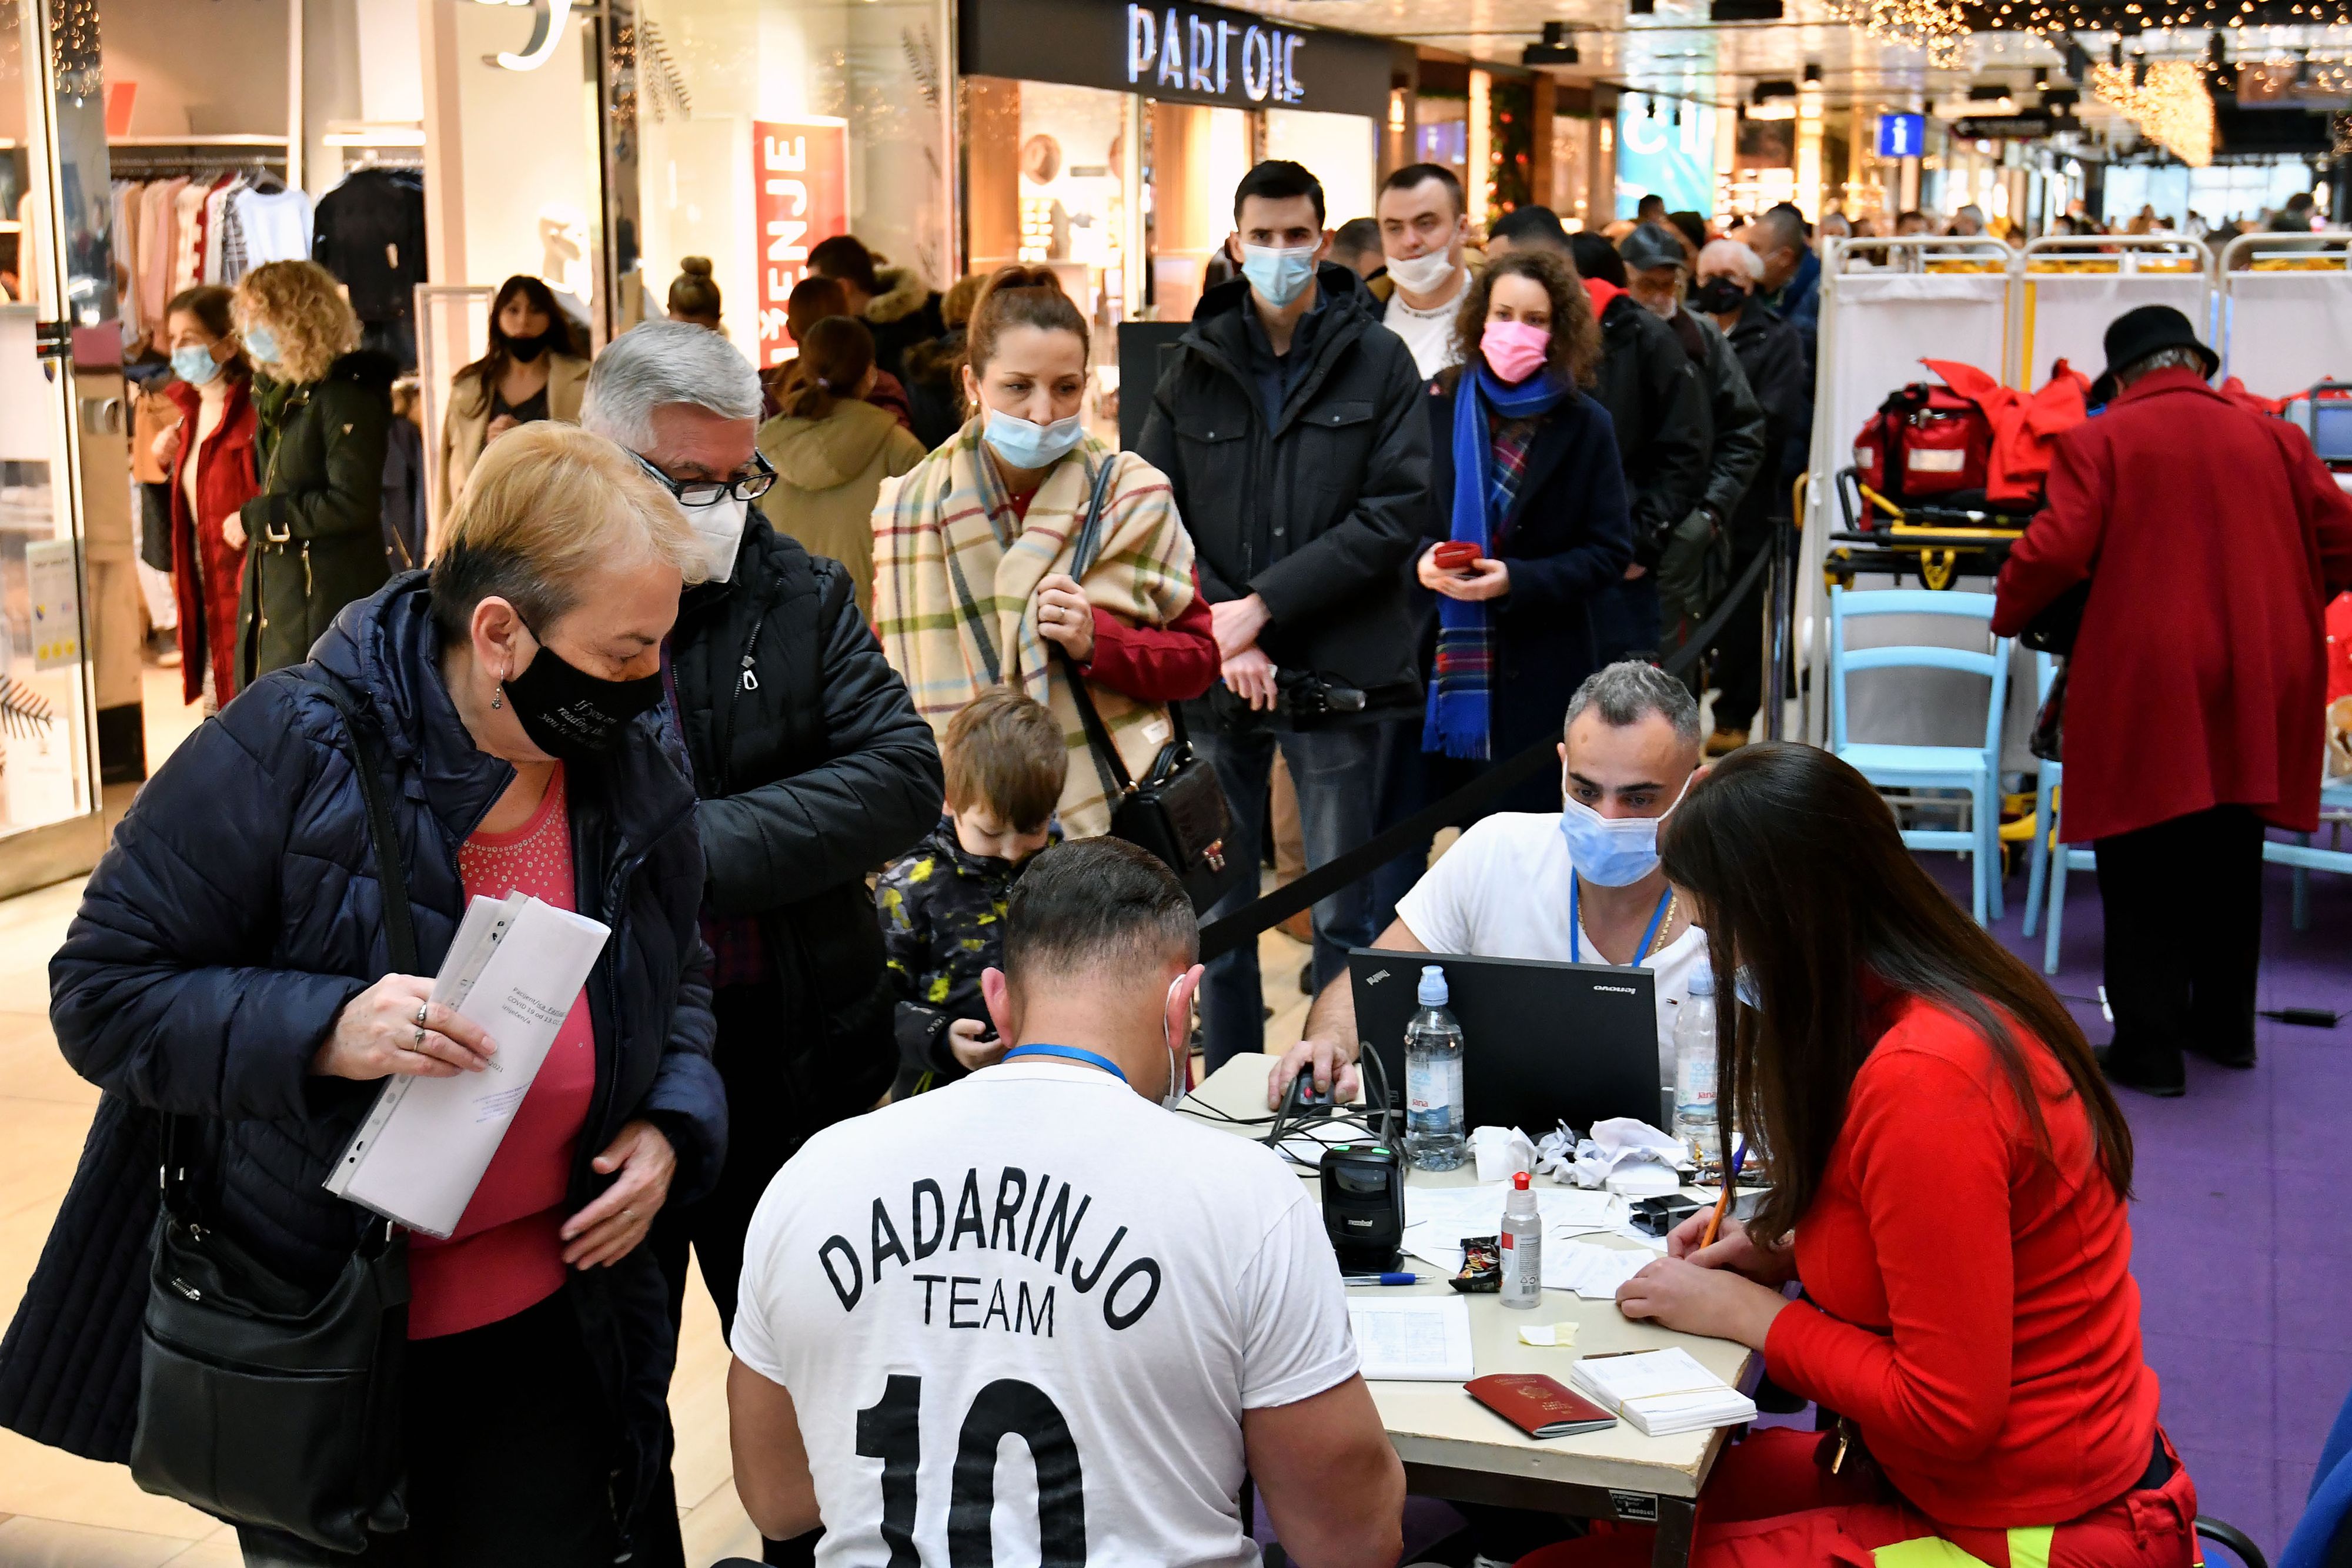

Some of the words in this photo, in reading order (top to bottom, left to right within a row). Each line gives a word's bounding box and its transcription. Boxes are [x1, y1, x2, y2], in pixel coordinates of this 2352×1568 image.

[574, 700, 593, 711] If
[582, 708, 604, 720] you
[557, 707, 593, 733] reading
[1593, 985, 1636, 994] lenovo
[507, 995, 527, 1009] COVID
[818, 1165, 1161, 1330] DADARINJO
[913, 1274, 1055, 1338] TEAM
[855, 1373, 1087, 1568] 10
